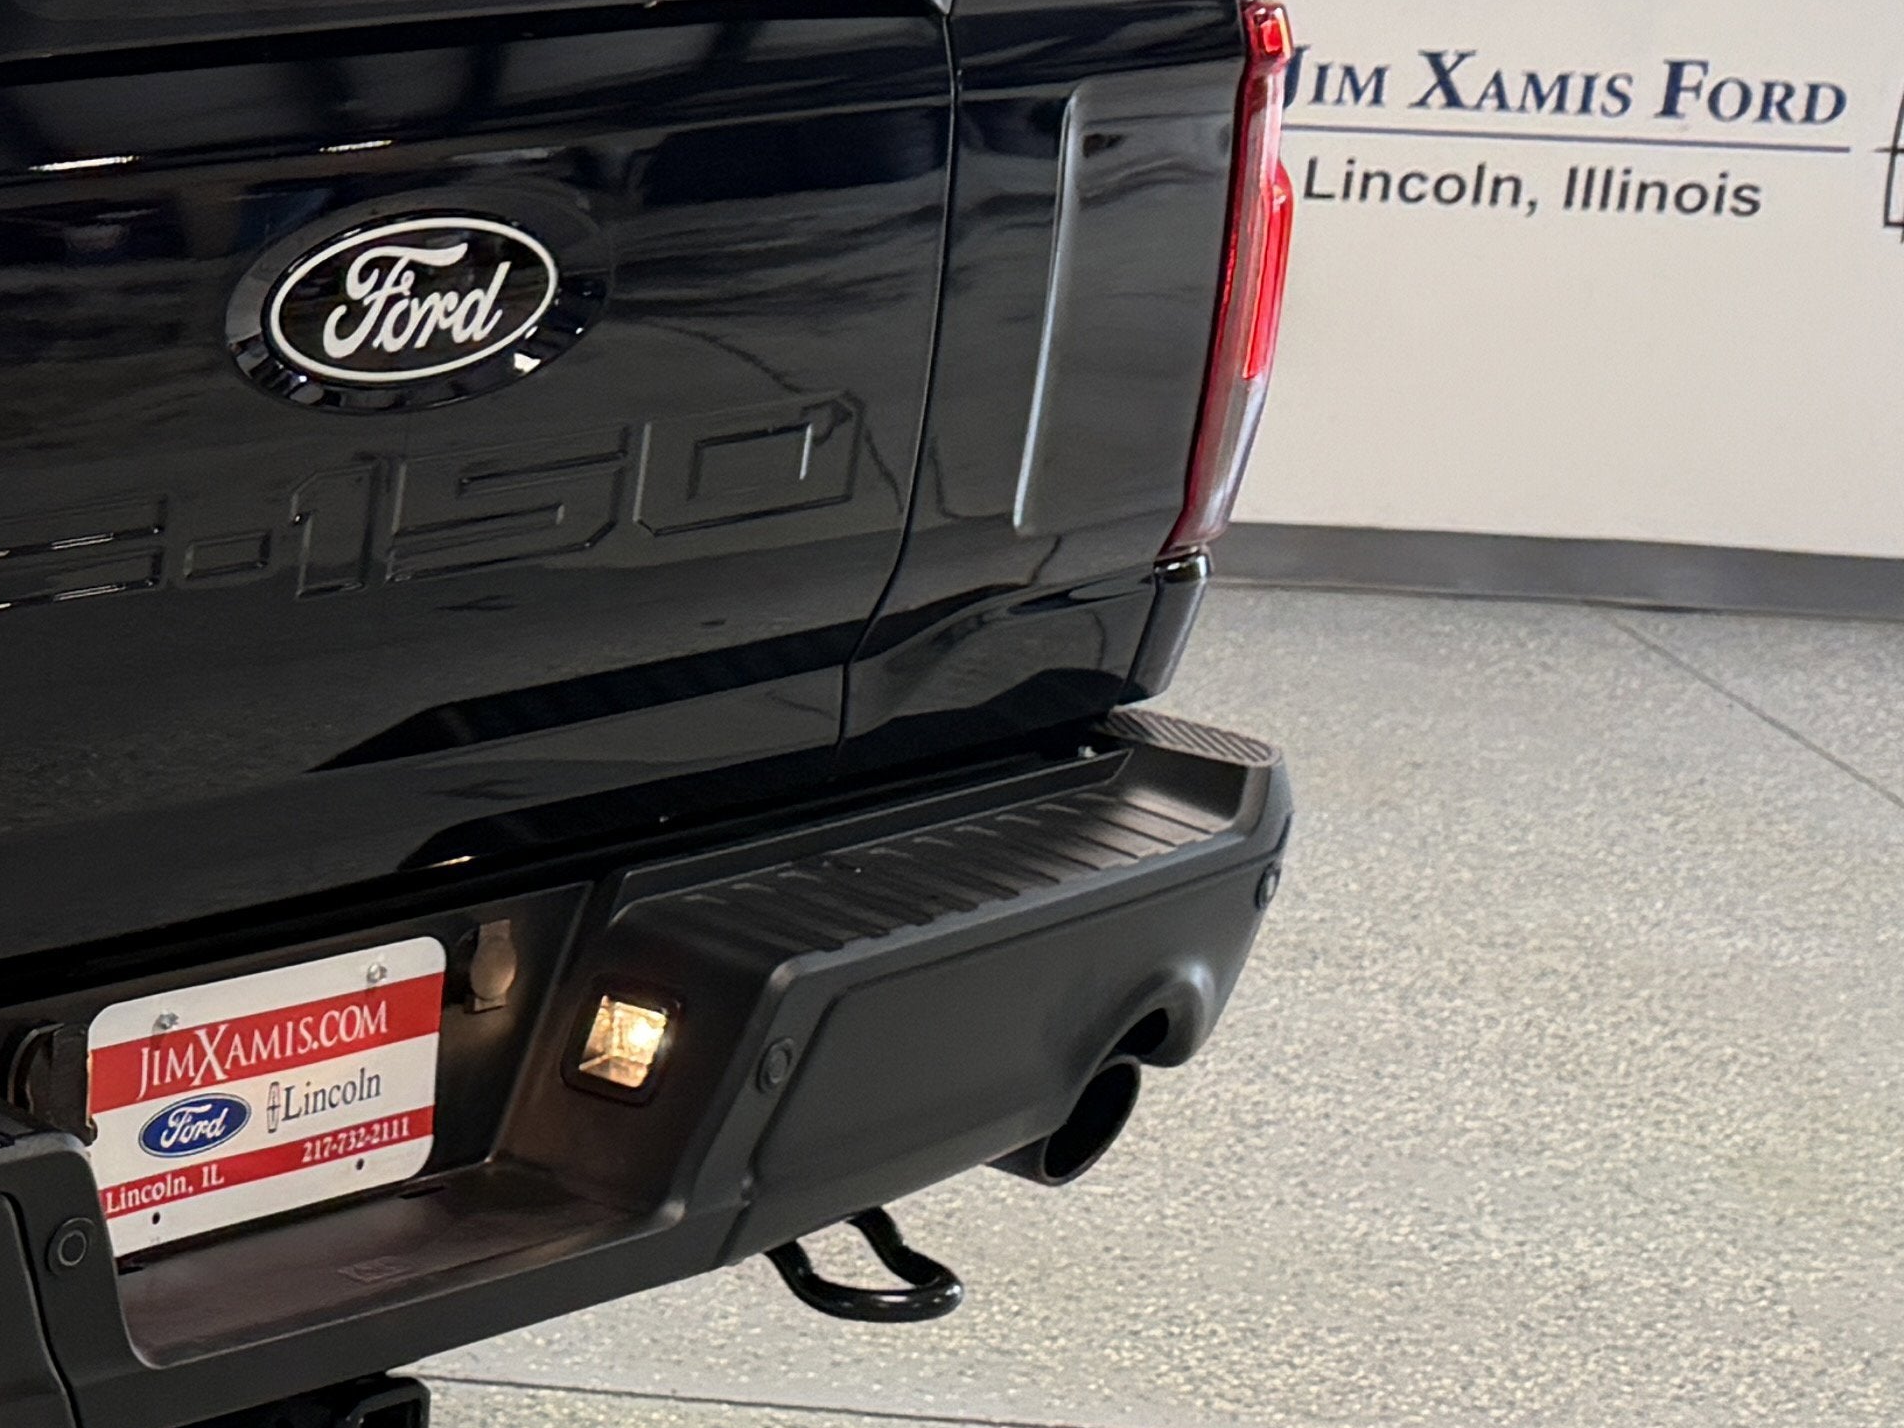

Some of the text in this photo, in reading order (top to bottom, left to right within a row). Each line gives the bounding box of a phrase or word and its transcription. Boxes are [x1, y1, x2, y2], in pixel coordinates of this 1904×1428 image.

[1282, 43, 1848, 126] JIM XAMIS FORD
[1302, 155, 1763, 218] Lincoln, Illinois
[322, 242, 512, 359] Ford
[135, 999, 389, 1101] JIMXAMIS.COM
[281, 1067, 382, 1122] Lincoln
[159, 1102, 229, 1149] Ford
[302, 1117, 411, 1164] 217-732-2111
[104, 1166, 225, 1214] Lincoln, IL
